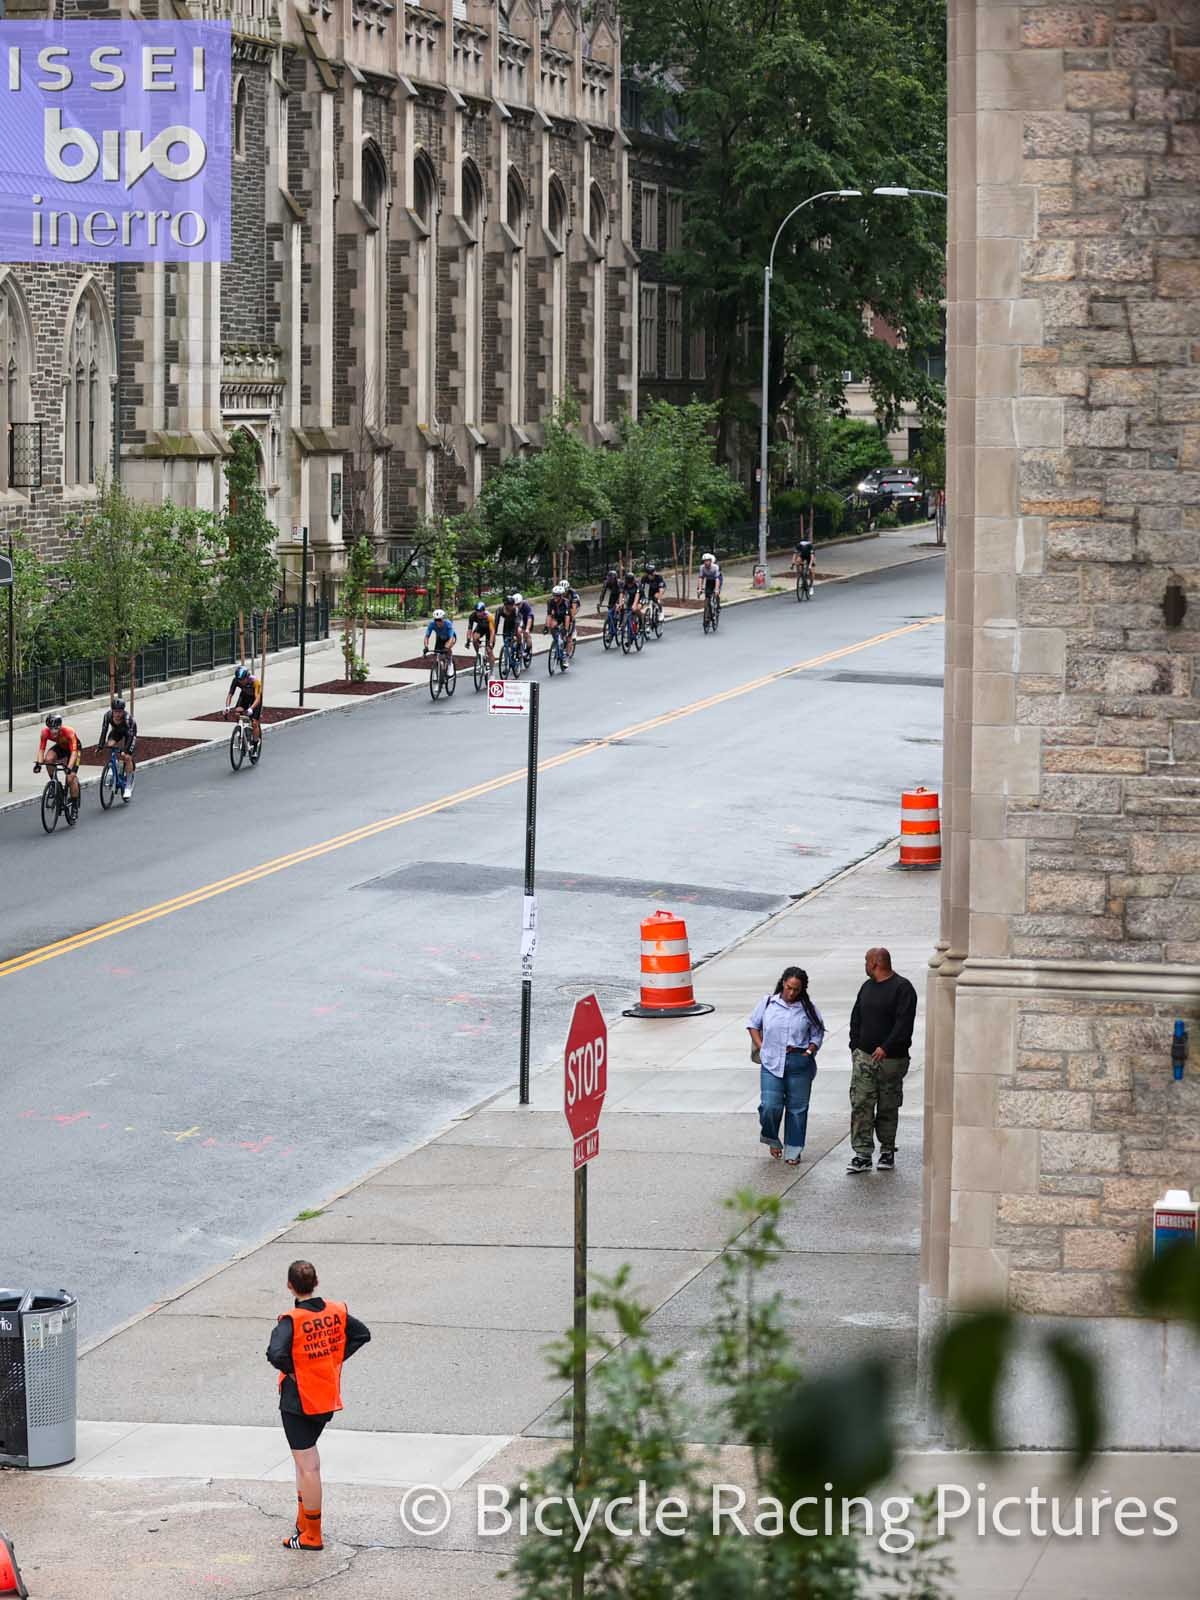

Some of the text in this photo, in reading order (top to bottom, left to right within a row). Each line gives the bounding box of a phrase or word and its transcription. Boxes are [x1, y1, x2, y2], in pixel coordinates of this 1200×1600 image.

[567, 1036, 605, 1106] STOP
[575, 1141, 585, 1161] ALL
[302, 1313, 342, 1333] CRCA
